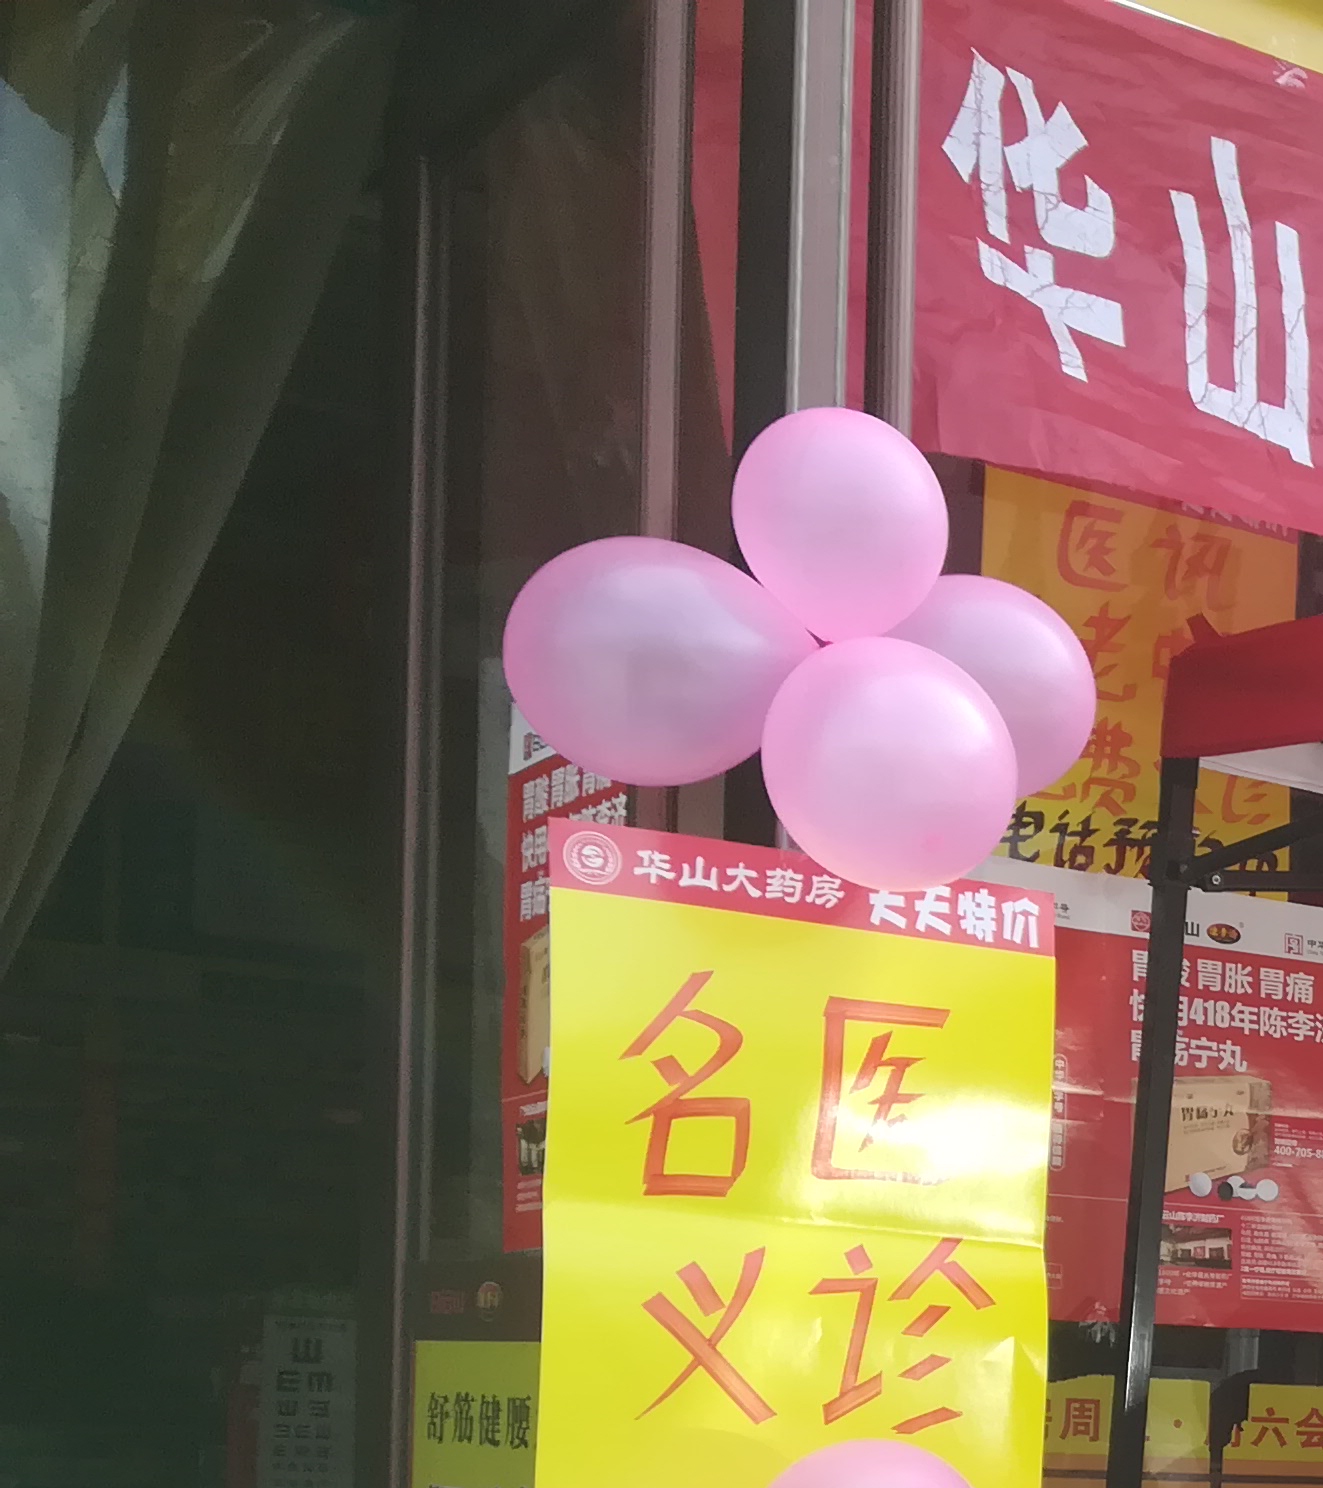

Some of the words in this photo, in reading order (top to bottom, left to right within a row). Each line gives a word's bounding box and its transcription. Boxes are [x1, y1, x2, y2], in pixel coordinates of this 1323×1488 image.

[633, 848, 846, 910] 华山大药房
[868, 885, 1042, 950] 天天特价
[1198, 957, 1254, 996] 胃胀
[1259, 966, 1316, 1006] 胃痛
[618, 969, 951, 1197] 名医
[633, 1236, 997, 1436] 义诊
